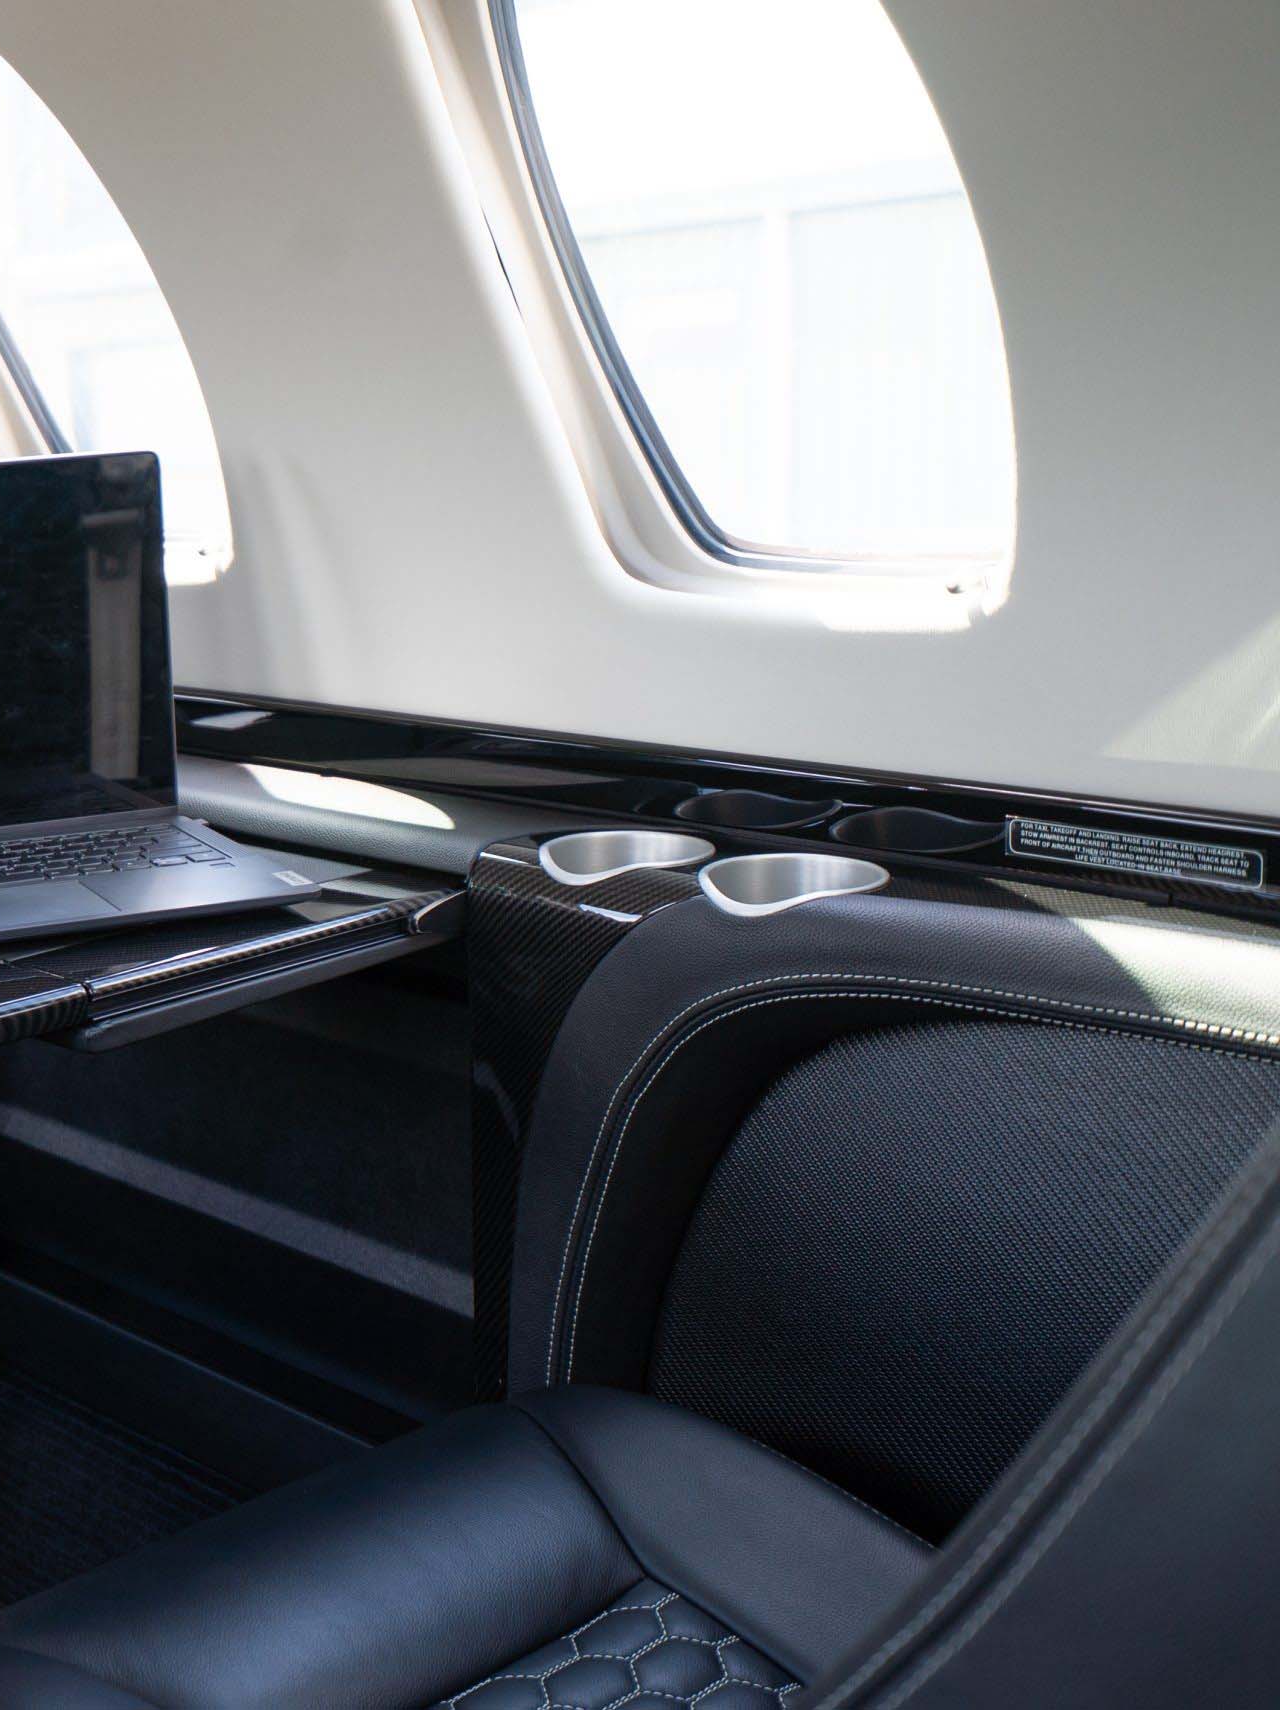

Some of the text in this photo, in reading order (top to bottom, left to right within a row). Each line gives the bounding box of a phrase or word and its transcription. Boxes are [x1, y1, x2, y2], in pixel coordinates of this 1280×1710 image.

[1020, 822, 1034, 830] FOR
[1050, 826, 1077, 836] TAKEOFF
[1078, 830, 1092, 838] AND
[1122, 836, 1140, 844] RAISE
[1142, 839, 1159, 847] SEAT
[1020, 830, 1038, 838] STOW
[1039, 833, 1067, 842] ARMREST
[1111, 842, 1127, 851] SEAT
[1197, 854, 1220, 864] TRACK
[1220, 857, 1238, 866] SEAT
[1020, 838, 1040, 847] FRONT
[1135, 854, 1149, 862] AND
[1149, 856, 1175, 866] FASTEN
[1176, 860, 1213, 871] SHOULDER
[1089, 856, 1105, 864] VEST
